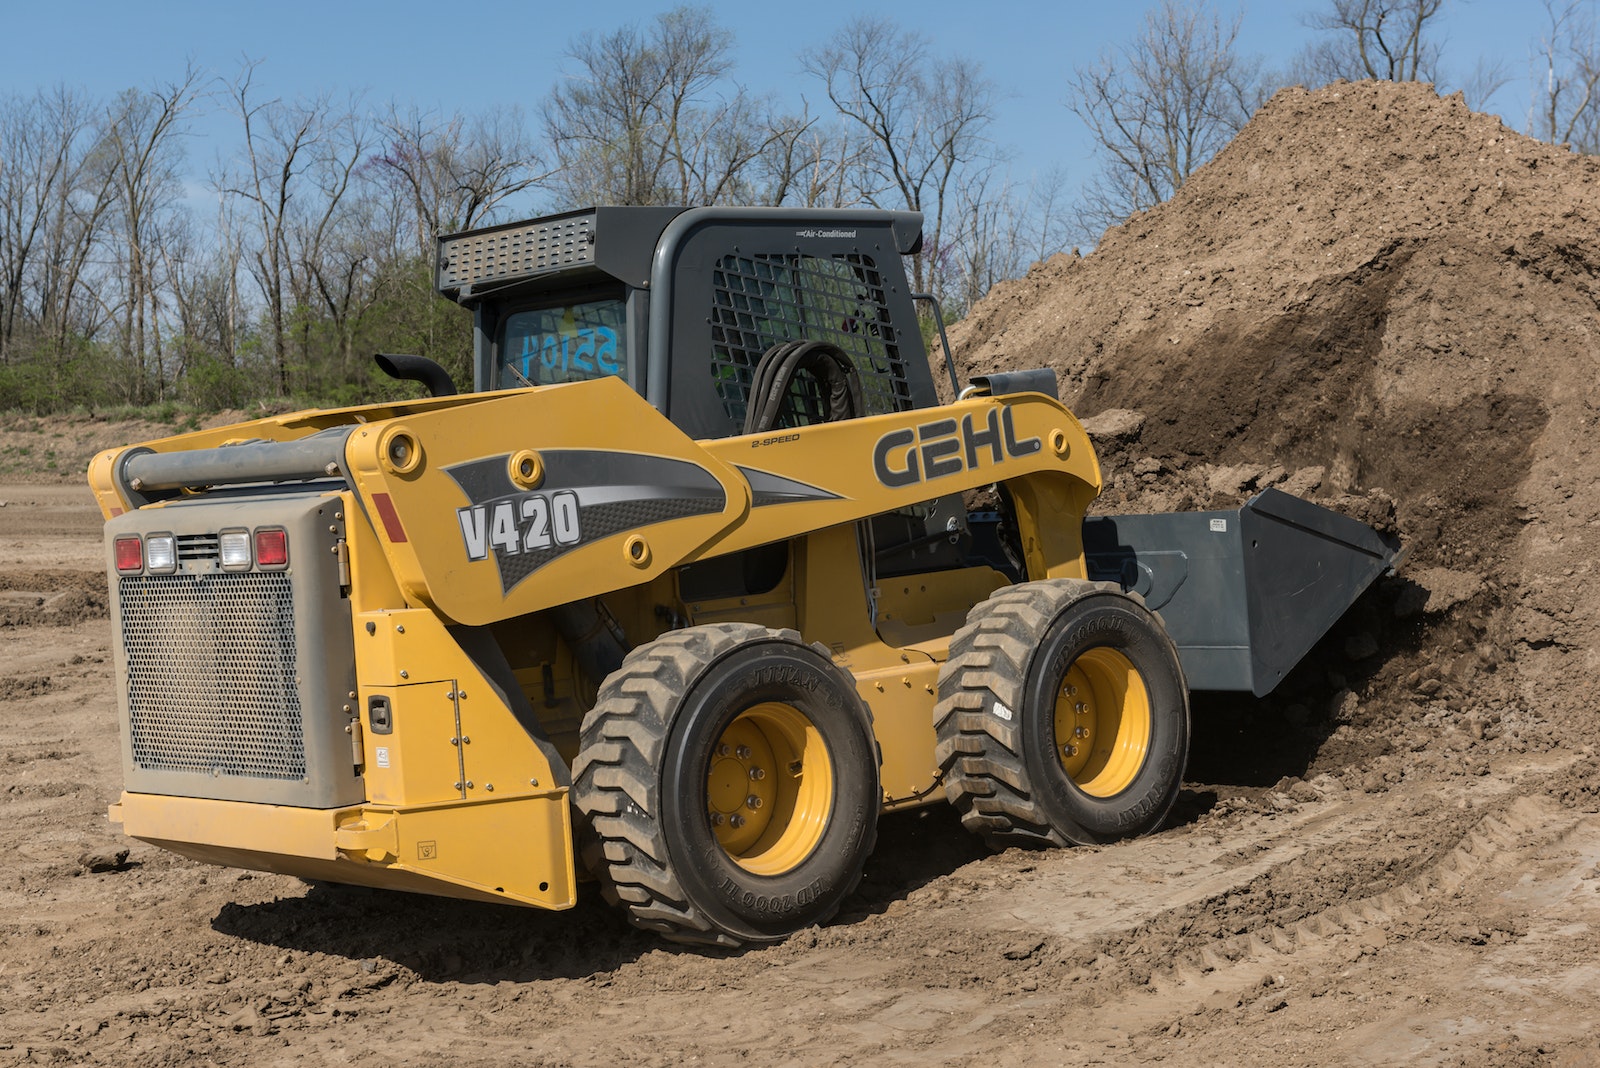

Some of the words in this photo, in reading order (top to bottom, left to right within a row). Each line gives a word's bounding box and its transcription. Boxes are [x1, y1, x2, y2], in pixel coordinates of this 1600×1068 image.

[806, 229, 857, 238] Air-Conditioned
[751, 433, 800, 448] 2-SPEED
[873, 404, 1042, 488] GEHL
[456, 489, 582, 562] V420
[753, 664, 821, 692] TITAN
